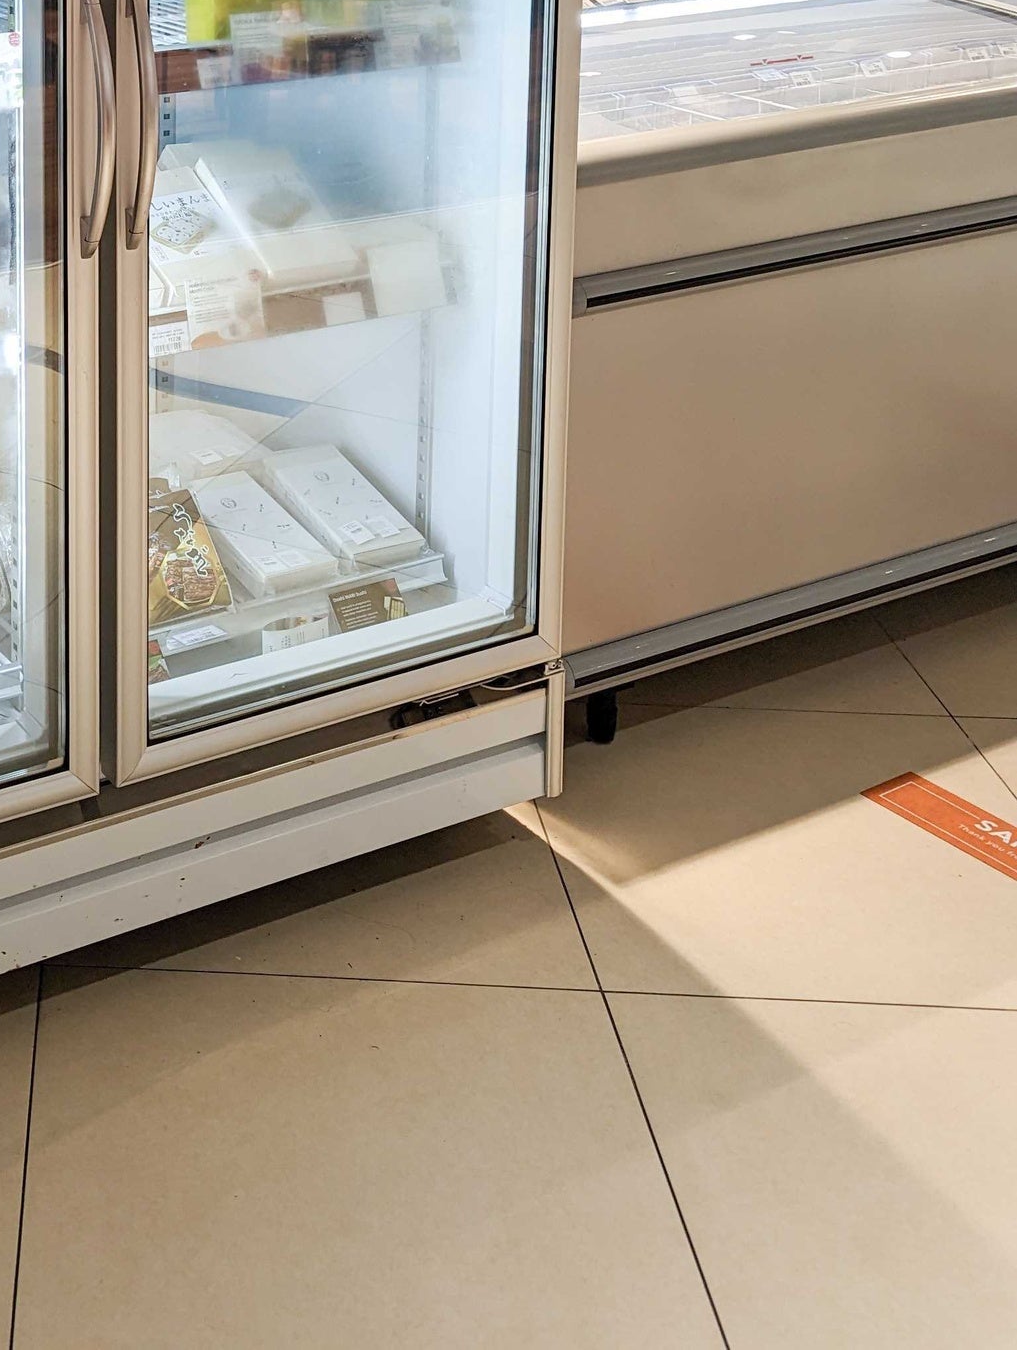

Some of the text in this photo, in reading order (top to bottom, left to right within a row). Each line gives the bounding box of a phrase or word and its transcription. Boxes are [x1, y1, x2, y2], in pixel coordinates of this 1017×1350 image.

[958, 824, 1005, 852] Thank you
[974, 820, 1017, 848] SA
